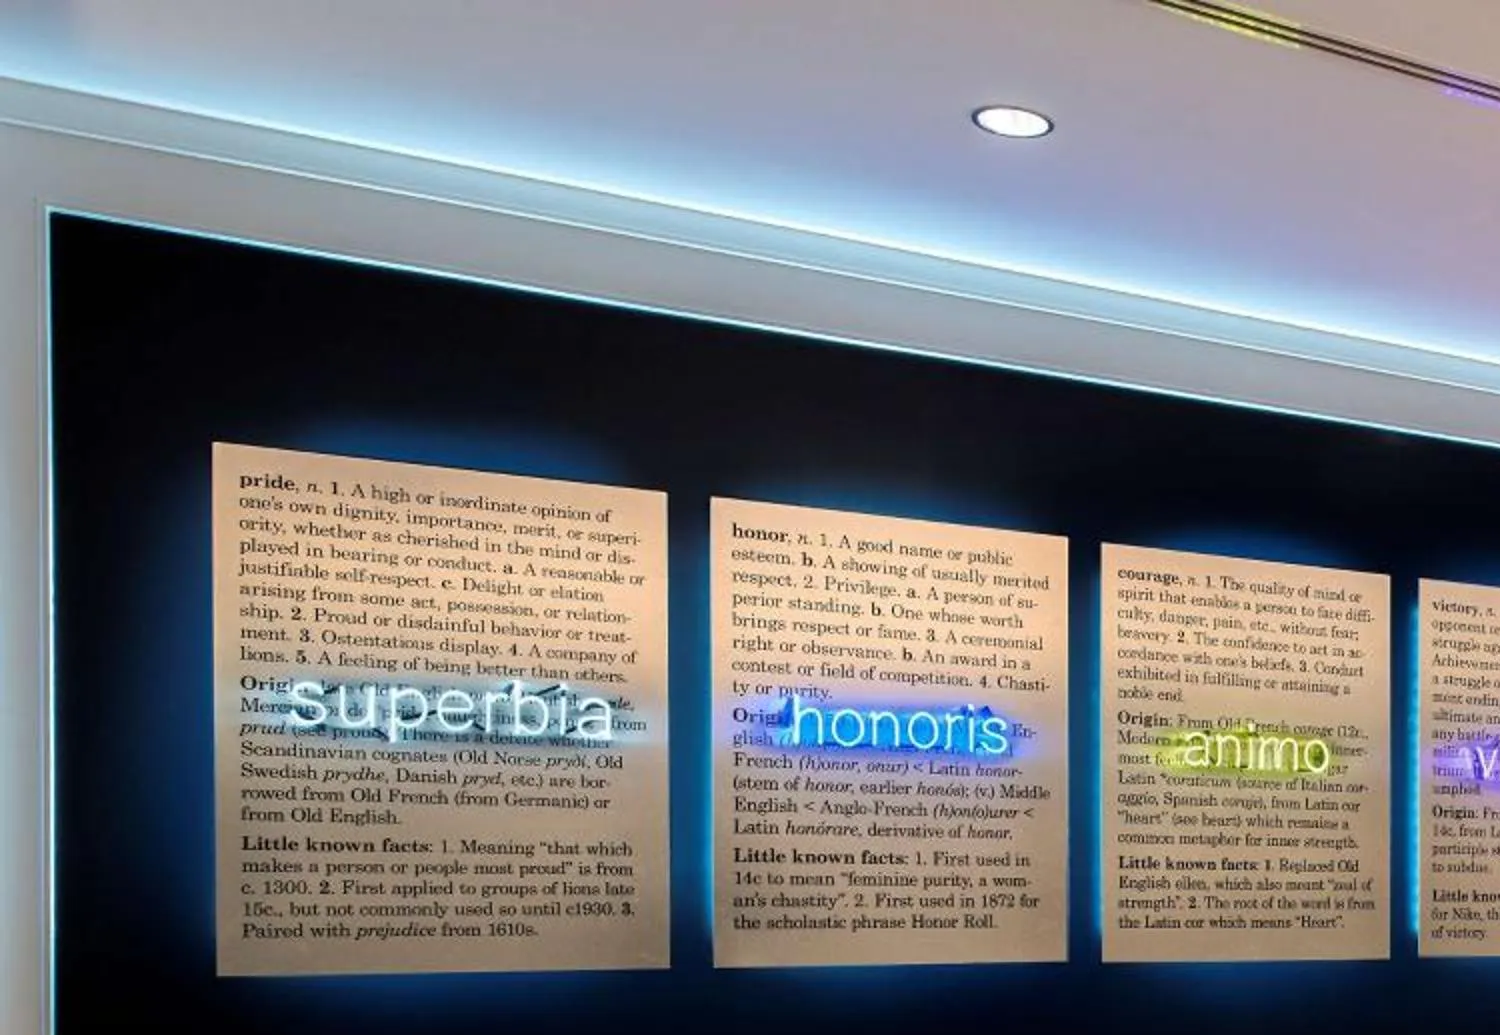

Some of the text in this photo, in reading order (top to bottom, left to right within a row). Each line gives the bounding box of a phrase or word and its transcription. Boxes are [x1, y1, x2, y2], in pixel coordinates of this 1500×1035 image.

[239, 472, 612, 523] pride, n. 1. A high or inordinate opinion of
[238, 515, 635, 564] ority, whether as cherished in the mind or dis-
[239, 495, 640, 547] one's own dignity, importance, merit, or superi-
[730, 549, 1049, 590] esteem. b. A showing of usually merited
[819, 532, 832, 548] 1.
[837, 534, 851, 550] A
[856, 538, 893, 554] good
[898, 543, 942, 559] name
[946, 548, 963, 560] or
[967, 549, 1012, 566] public
[730, 570, 797, 588] respect.
[824, 575, 900, 599] Privilege.
[905, 587, 920, 599] a.
[925, 585, 939, 600] A
[943, 591, 994, 606] person
[997, 592, 1014, 607] of
[1016, 597, 1038, 608] su-
[239, 601, 631, 643] ship. 2. Proud or disdainful behavior or treat-
[731, 610, 787, 632] brings
[791, 620, 849, 637] respect
[855, 625, 872, 637] or
[877, 623, 920, 641] fame.
[944, 629, 957, 645] A
[961, 635, 1043, 651] ceremonial
[240, 626, 638, 666] ment. 3. Ostentatious display. 4. A company of
[290, 681, 614, 740] superbia
[792, 695, 1008, 754] honoris
[1184, 723, 1329, 773] animo
[241, 834, 299, 851] Little
[304, 835, 375, 853] known
[381, 837, 432, 853] facts:
[460, 839, 535, 858] Meaning
[585, 840, 632, 857] which
[733, 847, 1030, 867] Little known facts: 1. First used in
[242, 919, 539, 940] Paired with prejudice from 1610s.
[732, 913, 761, 930] the
[766, 913, 846, 930] scholastic
[850, 913, 906, 933] phrase
[910, 913, 959, 928] Honor
